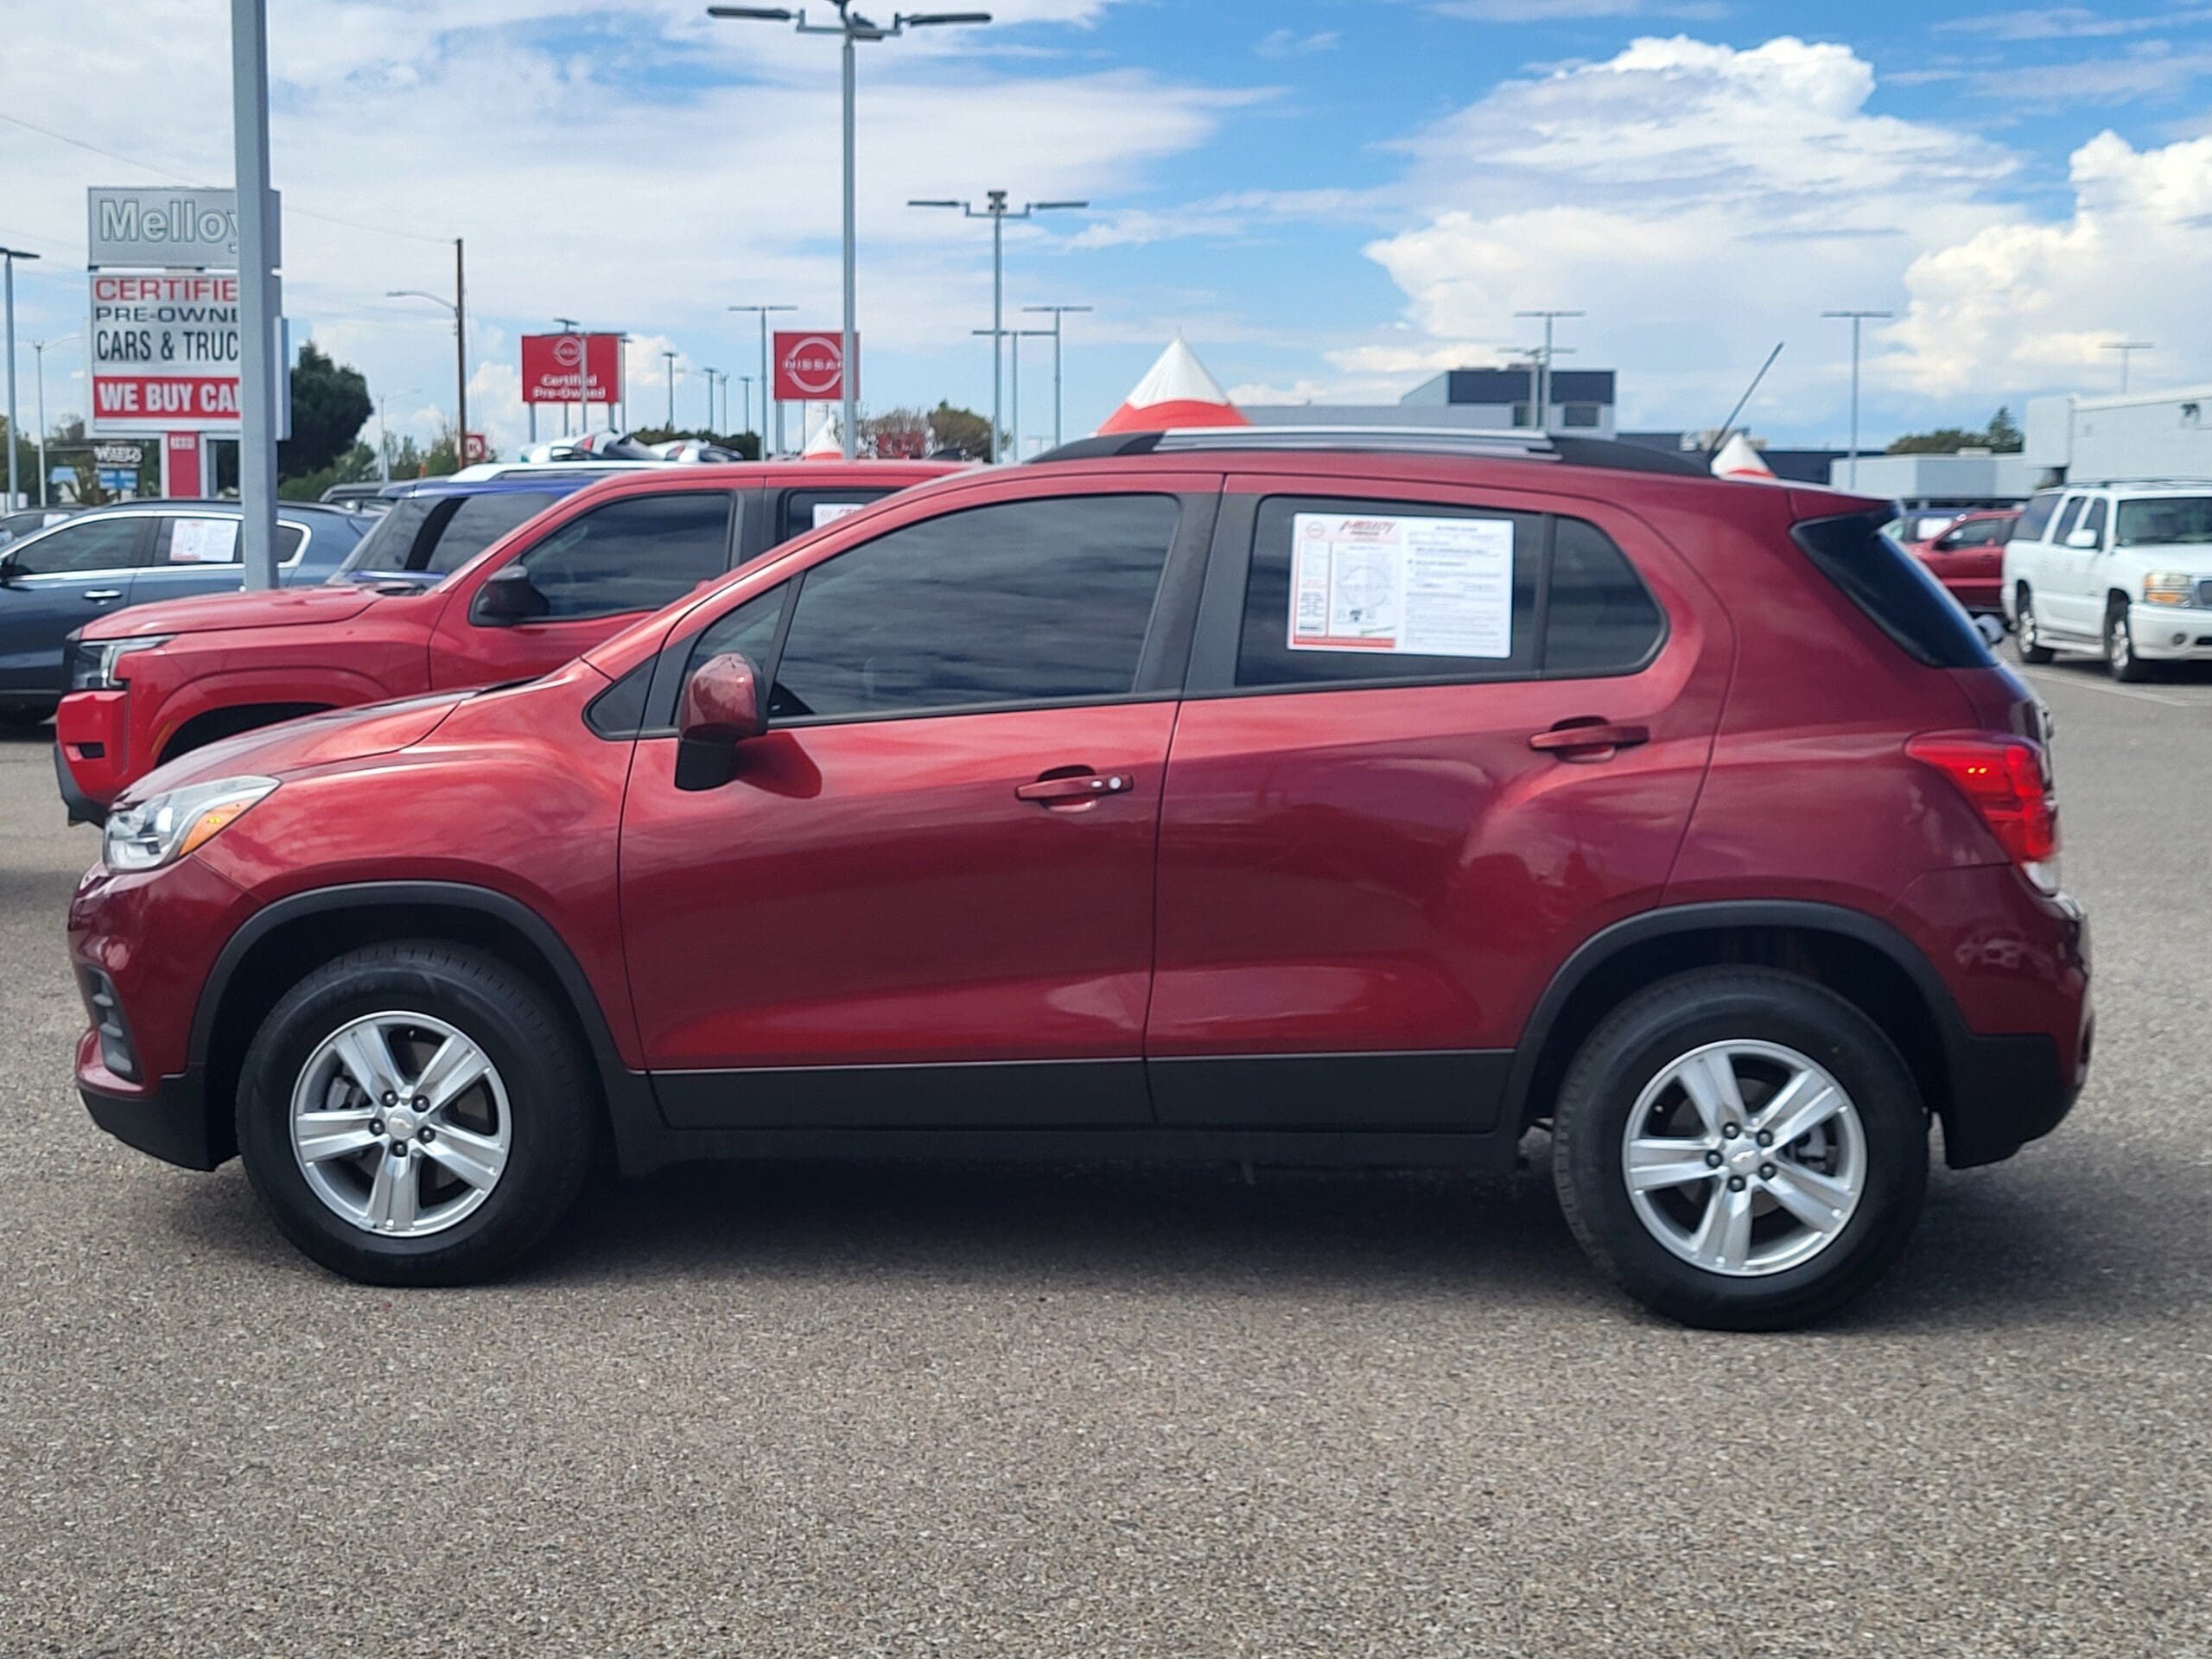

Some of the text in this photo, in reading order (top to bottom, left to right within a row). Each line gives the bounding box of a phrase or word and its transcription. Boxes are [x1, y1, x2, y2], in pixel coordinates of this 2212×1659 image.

[95, 278, 237, 302] CERTIFIE
[95, 307, 238, 323] PRE-OWNE
[97, 330, 238, 361] CARS & TRUC
[540, 373, 597, 387] Certifid
[98, 383, 238, 412] WE BUY CA
